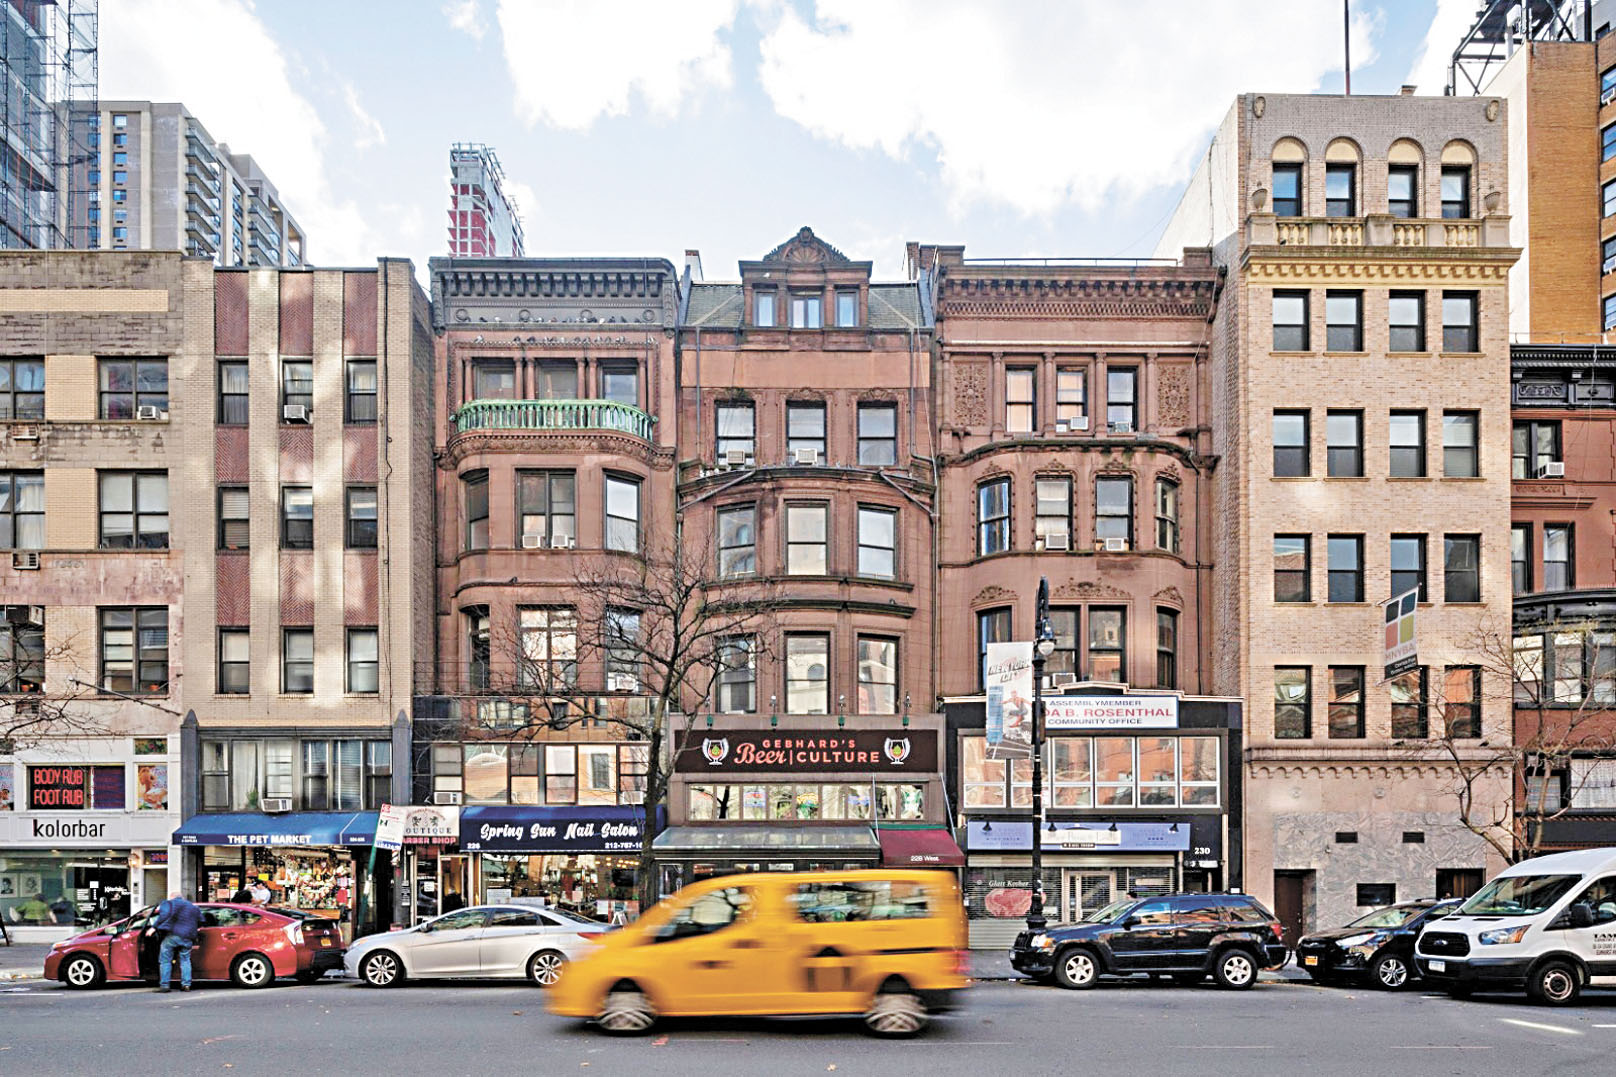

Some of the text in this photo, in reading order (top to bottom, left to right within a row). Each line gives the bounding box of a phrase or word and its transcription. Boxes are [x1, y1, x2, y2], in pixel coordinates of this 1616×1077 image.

[1065, 709, 1079, 717] B.
[1084, 709, 1173, 717] ROSENTHAL
[762, 739, 856, 749] GEBHARD'S
[733, 742, 880, 765] Beer CULTURE
[34, 768, 83, 785] BODY RUB
[34, 789, 84, 805] FOOT RUB
[33, 819, 106, 838] kolorbar
[480, 822, 638, 841] Spring Sun Nail Salon
[227, 835, 312, 844] THE PET MARKET
[403, 836, 430, 844] ARBER
[432, 836, 457, 844] SHOP
[1194, 847, 1211, 855] 230
